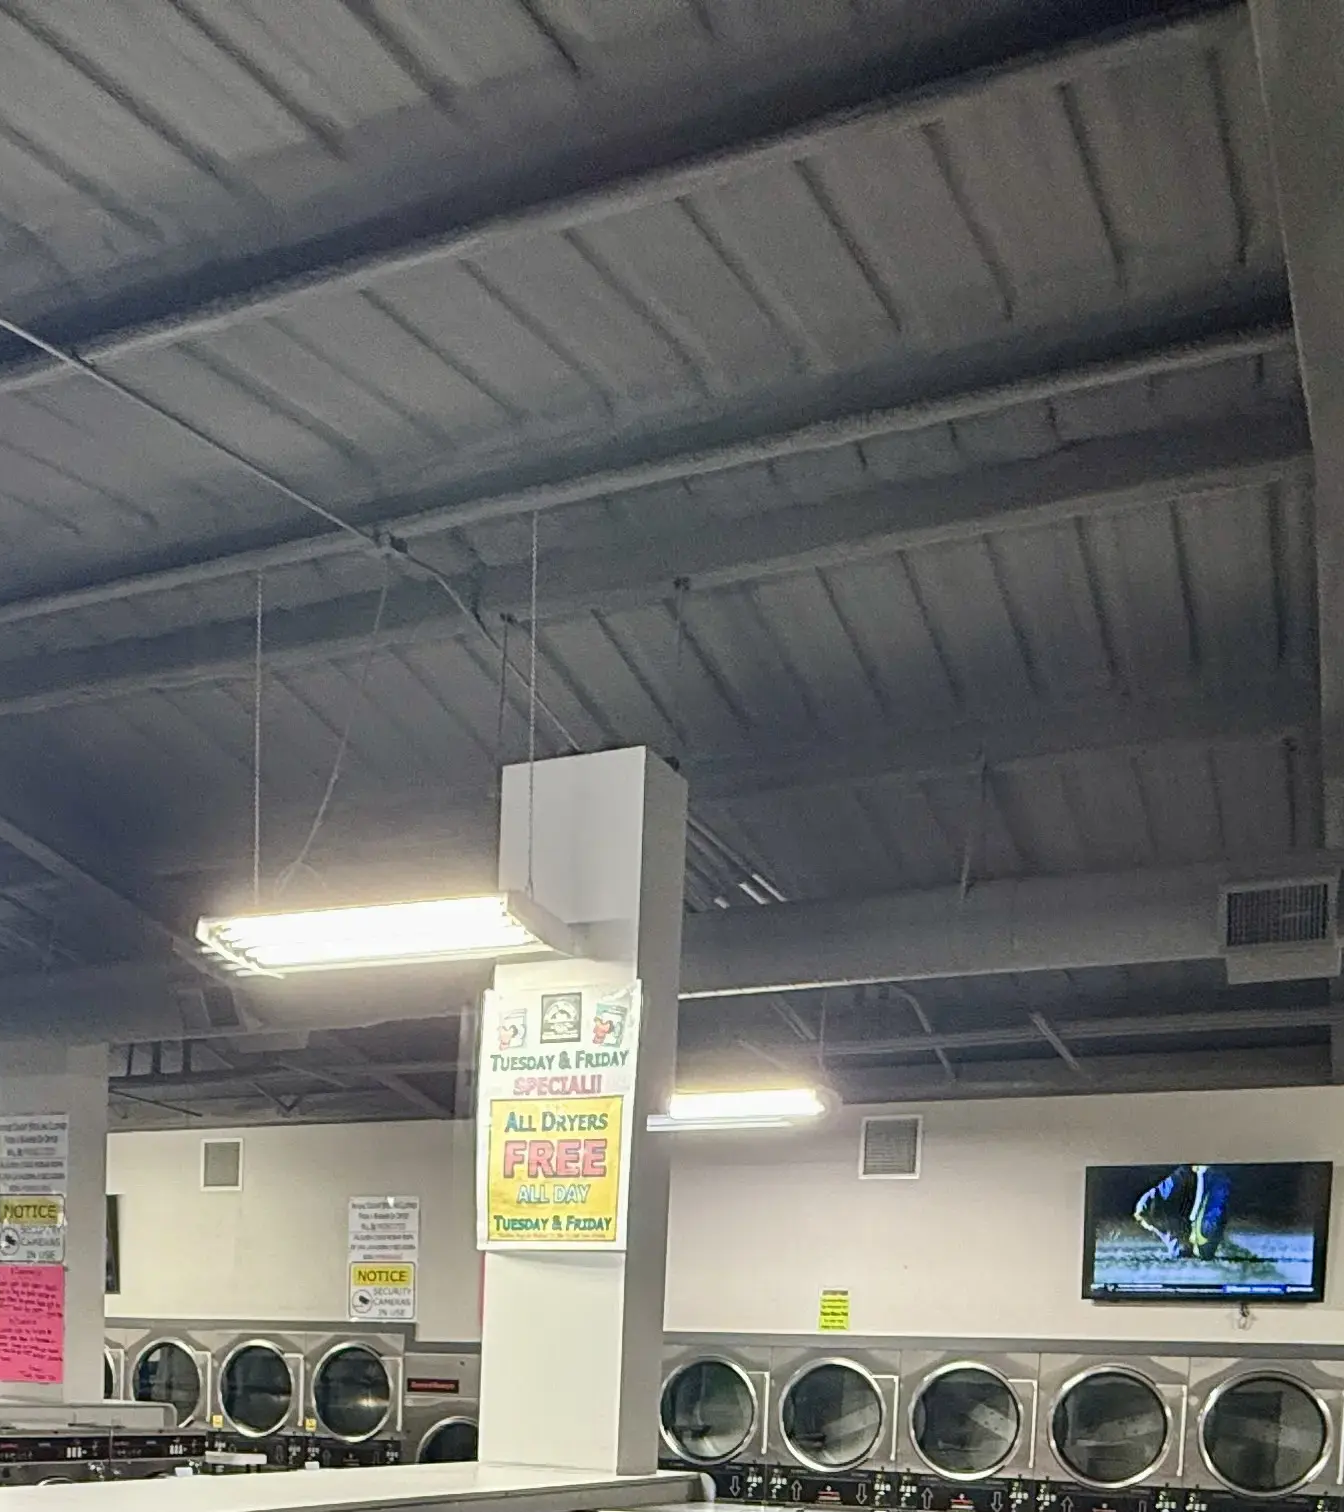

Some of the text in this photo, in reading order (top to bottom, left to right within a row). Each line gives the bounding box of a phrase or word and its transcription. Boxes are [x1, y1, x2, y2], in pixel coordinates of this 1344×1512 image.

[490, 1049, 629, 1072] TUESDAY & FRIDAY
[504, 1111, 609, 1133] ALL DRYERS
[503, 1138, 608, 1179] FREE
[516, 1184, 591, 1204] ALL DAY
[4, 1204, 56, 1218] NOTICE
[493, 1215, 613, 1232] TUESDAY & FRIDAY
[358, 1270, 408, 1282] NOTICE
